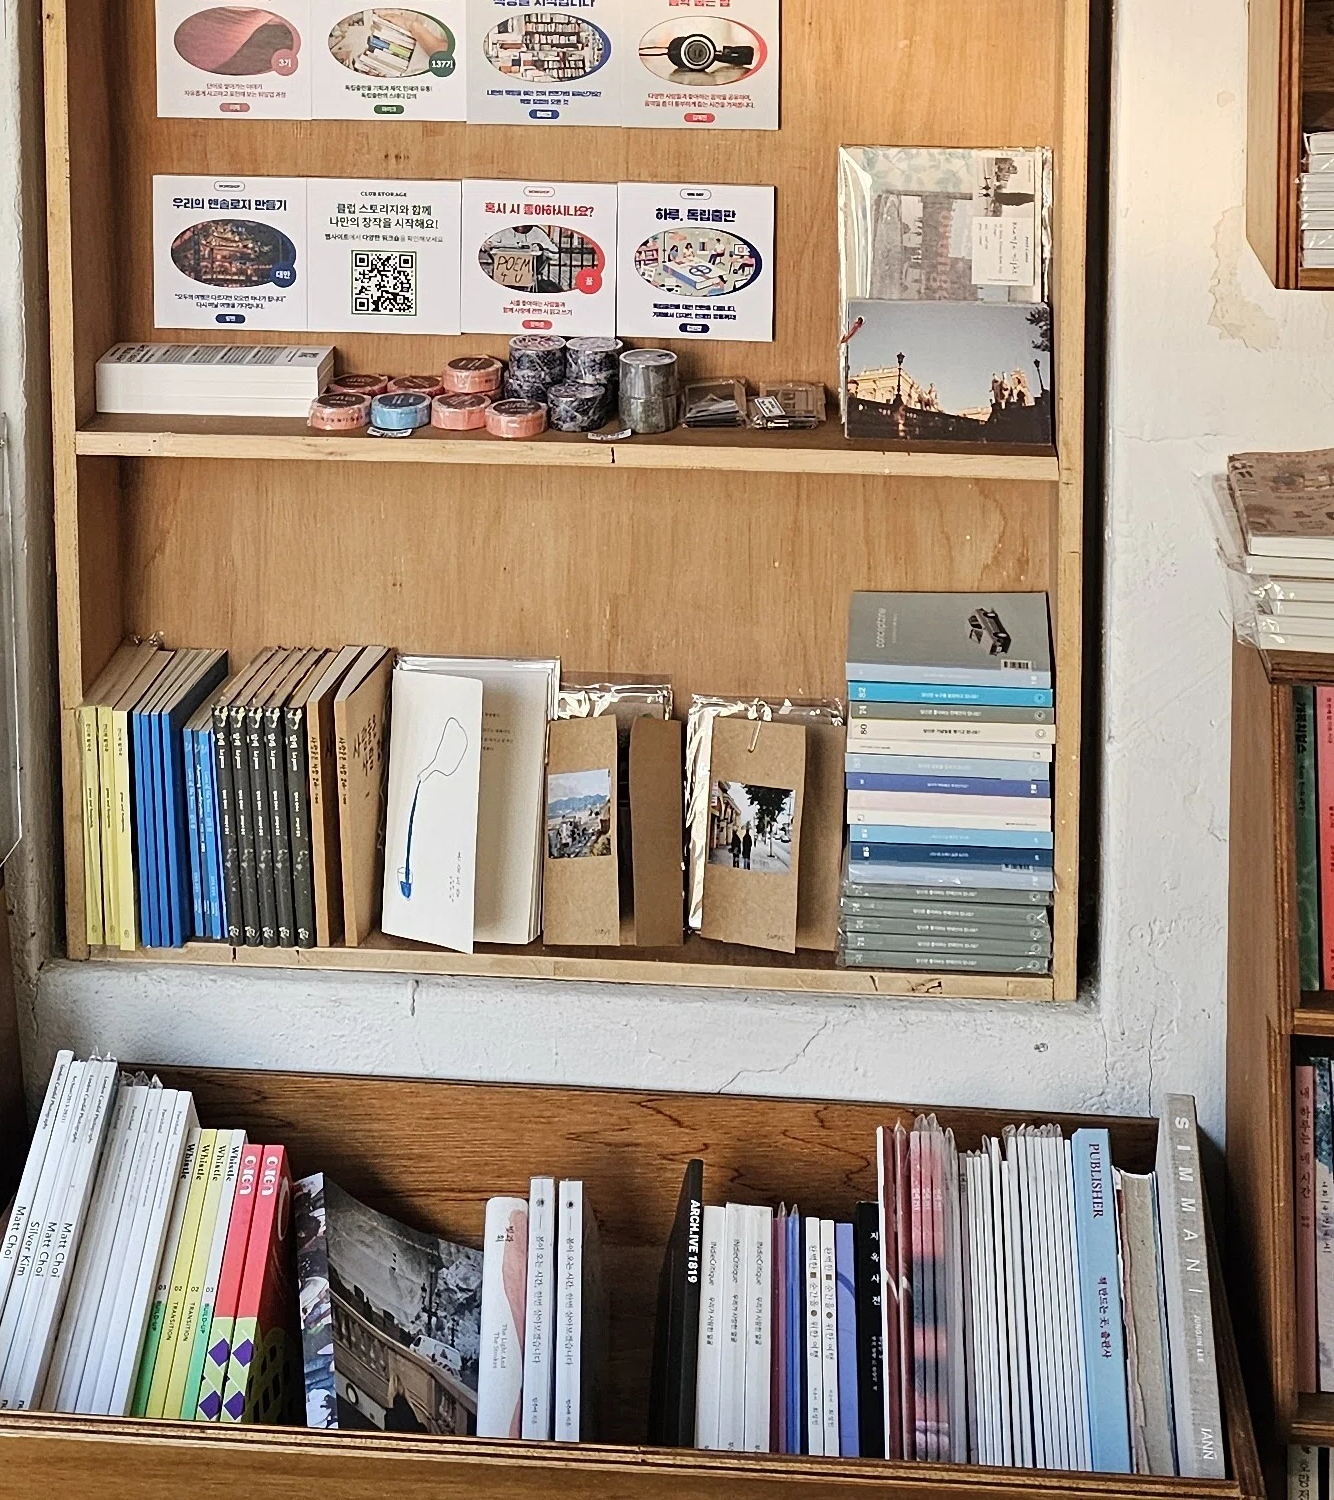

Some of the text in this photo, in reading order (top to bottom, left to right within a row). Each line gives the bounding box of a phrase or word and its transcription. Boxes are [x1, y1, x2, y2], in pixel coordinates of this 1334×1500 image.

[172, 198, 204, 210] 우리의
[254, 199, 287, 211] 만들기
[336, 204, 432, 216] 클럽 스토리지와 함께
[485, 202, 506, 215] 혹시
[510, 202, 520, 215] 시
[329, 217, 439, 230] 나만의 창작을 시작해요!
[496, 254, 530, 271] POEM
[181, 1143, 195, 1180] Whistle
[196, 1144, 210, 1181] Whistle
[1088, 1142, 1104, 1220] PUBLISHER
[1174, 1115, 1203, 1296] SIMMANI
[4, 1206, 26, 1259] Matt Choi
[17, 1222, 40, 1276] Silver Kim
[687, 1199, 700, 1284] ARCH.IVE 1819
[535, 1253, 544, 1269] 오는
[166, 1302, 178, 1341] TRANSITION
